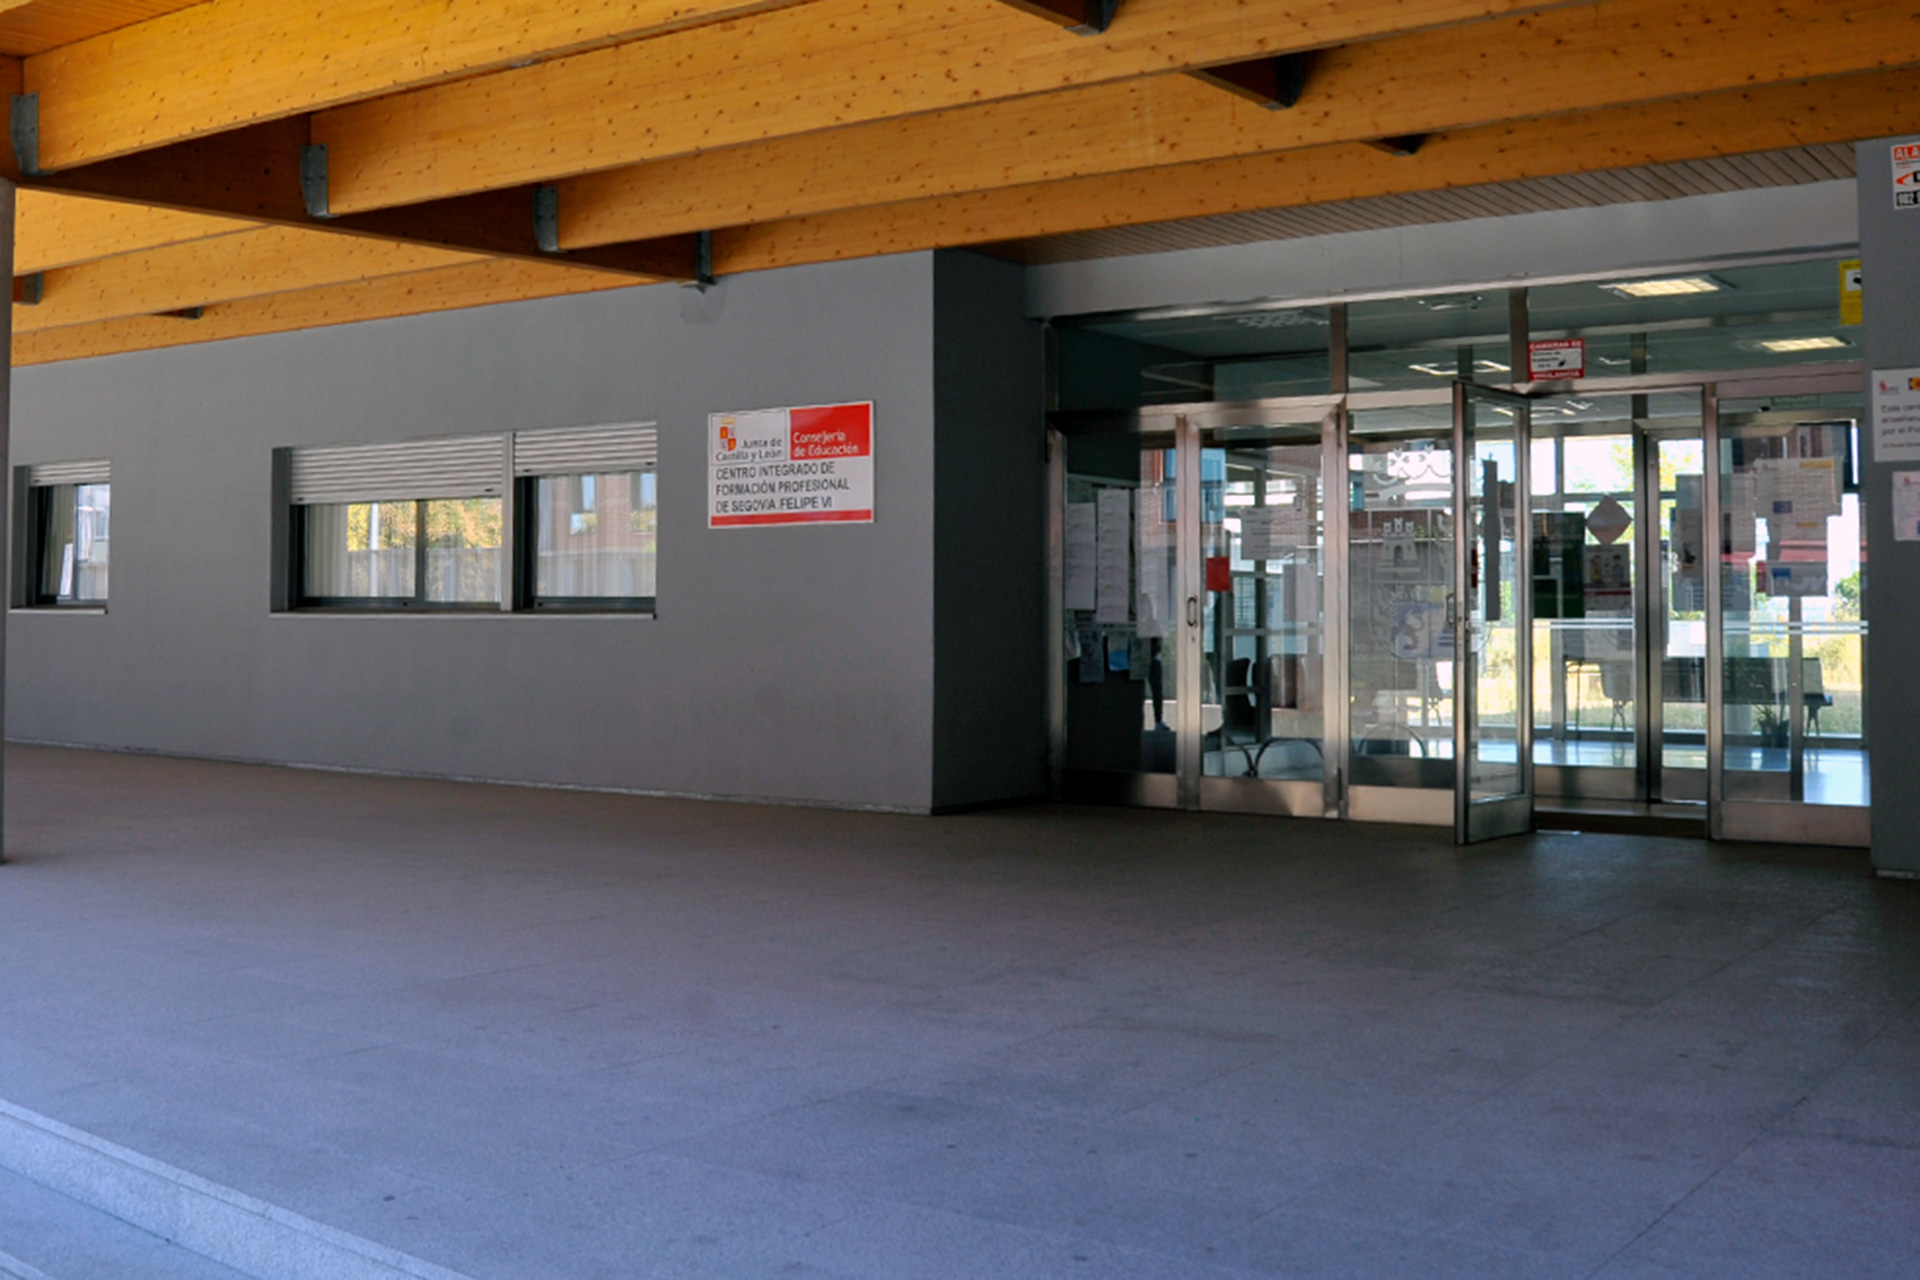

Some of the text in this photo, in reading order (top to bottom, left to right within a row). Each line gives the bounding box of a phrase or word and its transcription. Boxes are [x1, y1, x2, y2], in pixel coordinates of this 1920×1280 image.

[741, 437, 783, 449] Junta de
[793, 431, 847, 445] Consejería
[715, 449, 783, 462] Castilla y León
[793, 442, 860, 457] de Educación
[715, 461, 835, 480] CENTRO INTEGRADO DE
[715, 478, 850, 496] FORMACIÓN PROFESIONAL
[715, 495, 832, 513] DE SEGOVIA FELIPE VI
